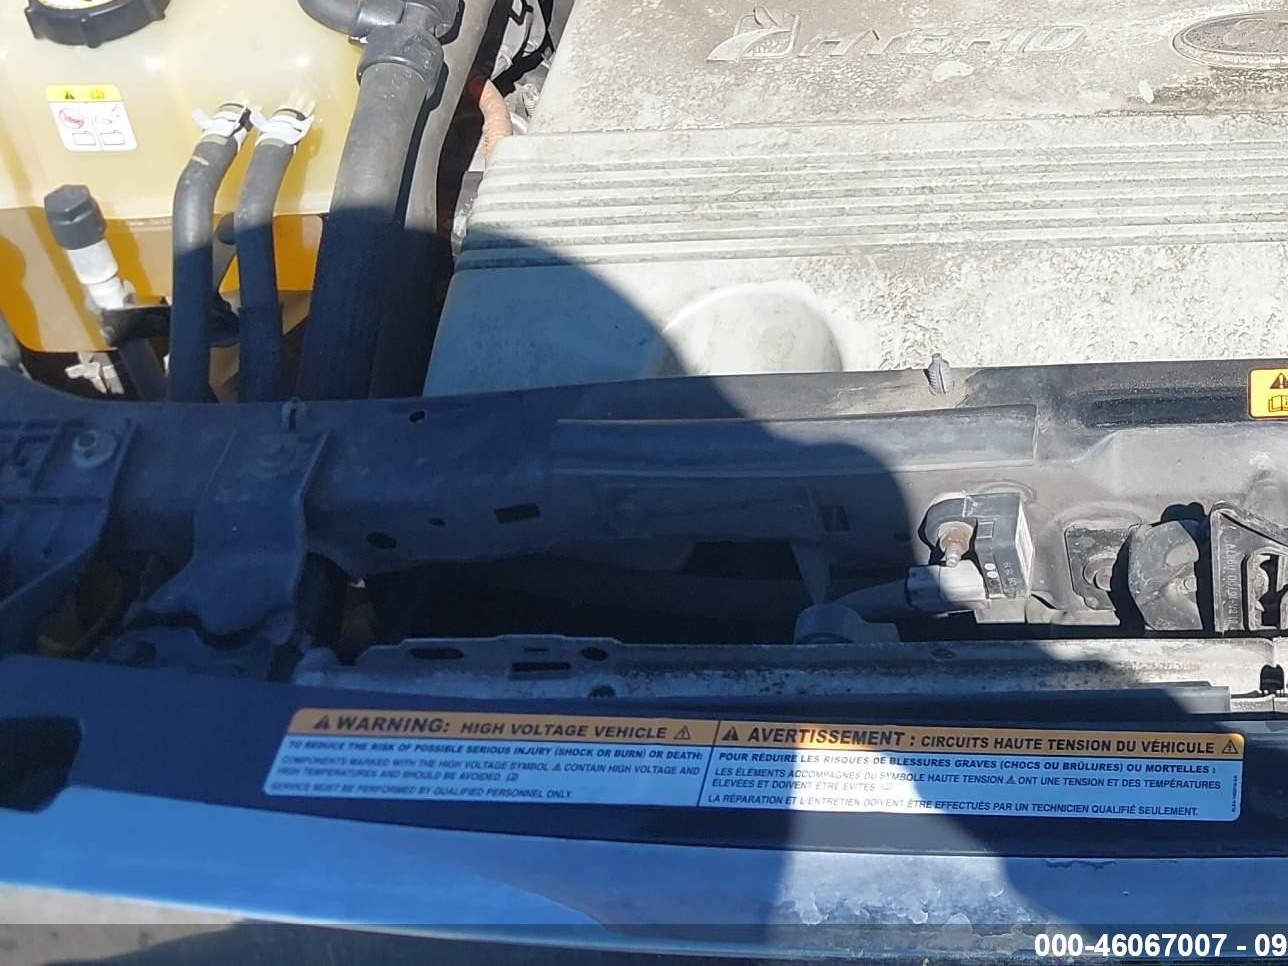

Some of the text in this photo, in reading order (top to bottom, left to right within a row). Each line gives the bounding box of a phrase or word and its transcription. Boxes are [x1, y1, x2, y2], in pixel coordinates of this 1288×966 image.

[337, 716, 668, 738] WARNING: HIGH VOLTAGE VEHICLE
[350, 743, 366, 751] THE
[372, 743, 394, 752] RISK
[399, 744, 410, 752] OF
[414, 744, 464, 753] POSSIBLE
[466, 746, 510, 755] SERIOUS
[514, 747, 551, 756] INJURY
[554, 748, 594, 757] (SHOCK
[597, 749, 611, 757] OR
[614, 749, 646, 758] BURN)
[649, 750, 664, 759] OR
[666, 751, 703, 760] DEATH:
[747, 728, 1214, 754] AVERTISSEMENT CIRCUITS HAUTE TENSION DU VÉHICULE
[419, 760, 436, 768] THE
[564, 764, 605, 772] CONTAIN
[608, 765, 632, 773] HIGH
[635, 766, 677, 774] VOLTAGE
[679, 767, 700, 775] AND
[719, 752, 1210, 773] POUR RÉDUIRE LES RISQUES DE BLESSURES GRAVES (CHOCS OU BRÛLURES) OU MORTELLES
[712, 778, 754, 788] ÉLEVÉES
[756, 780, 770, 788] ET
[772, 781, 812, 790] DOIVENT
[715, 767, 1220, 789] LES ÉLÉMENTS DU SYMBOLE HAUTE TENSION ONT UNE TENSION ET DES TEMPÉRATURES
[708, 795, 720, 803] LA
[722, 794, 783, 805] RÉPARATION
[786, 797, 798, 805] ET
[864, 799, 904, 808] DOIVENT
[935, 799, 990, 810] EFFECTUÉS
[993, 802, 1012, 811] PAR
[1015, 803, 1030, 811] UN
[1032, 803, 1089, 813] TECHNICIEN
[1092, 803, 1136, 814] QUALIFIÉ
[1138, 806, 1198, 815] SEULEMENT.
